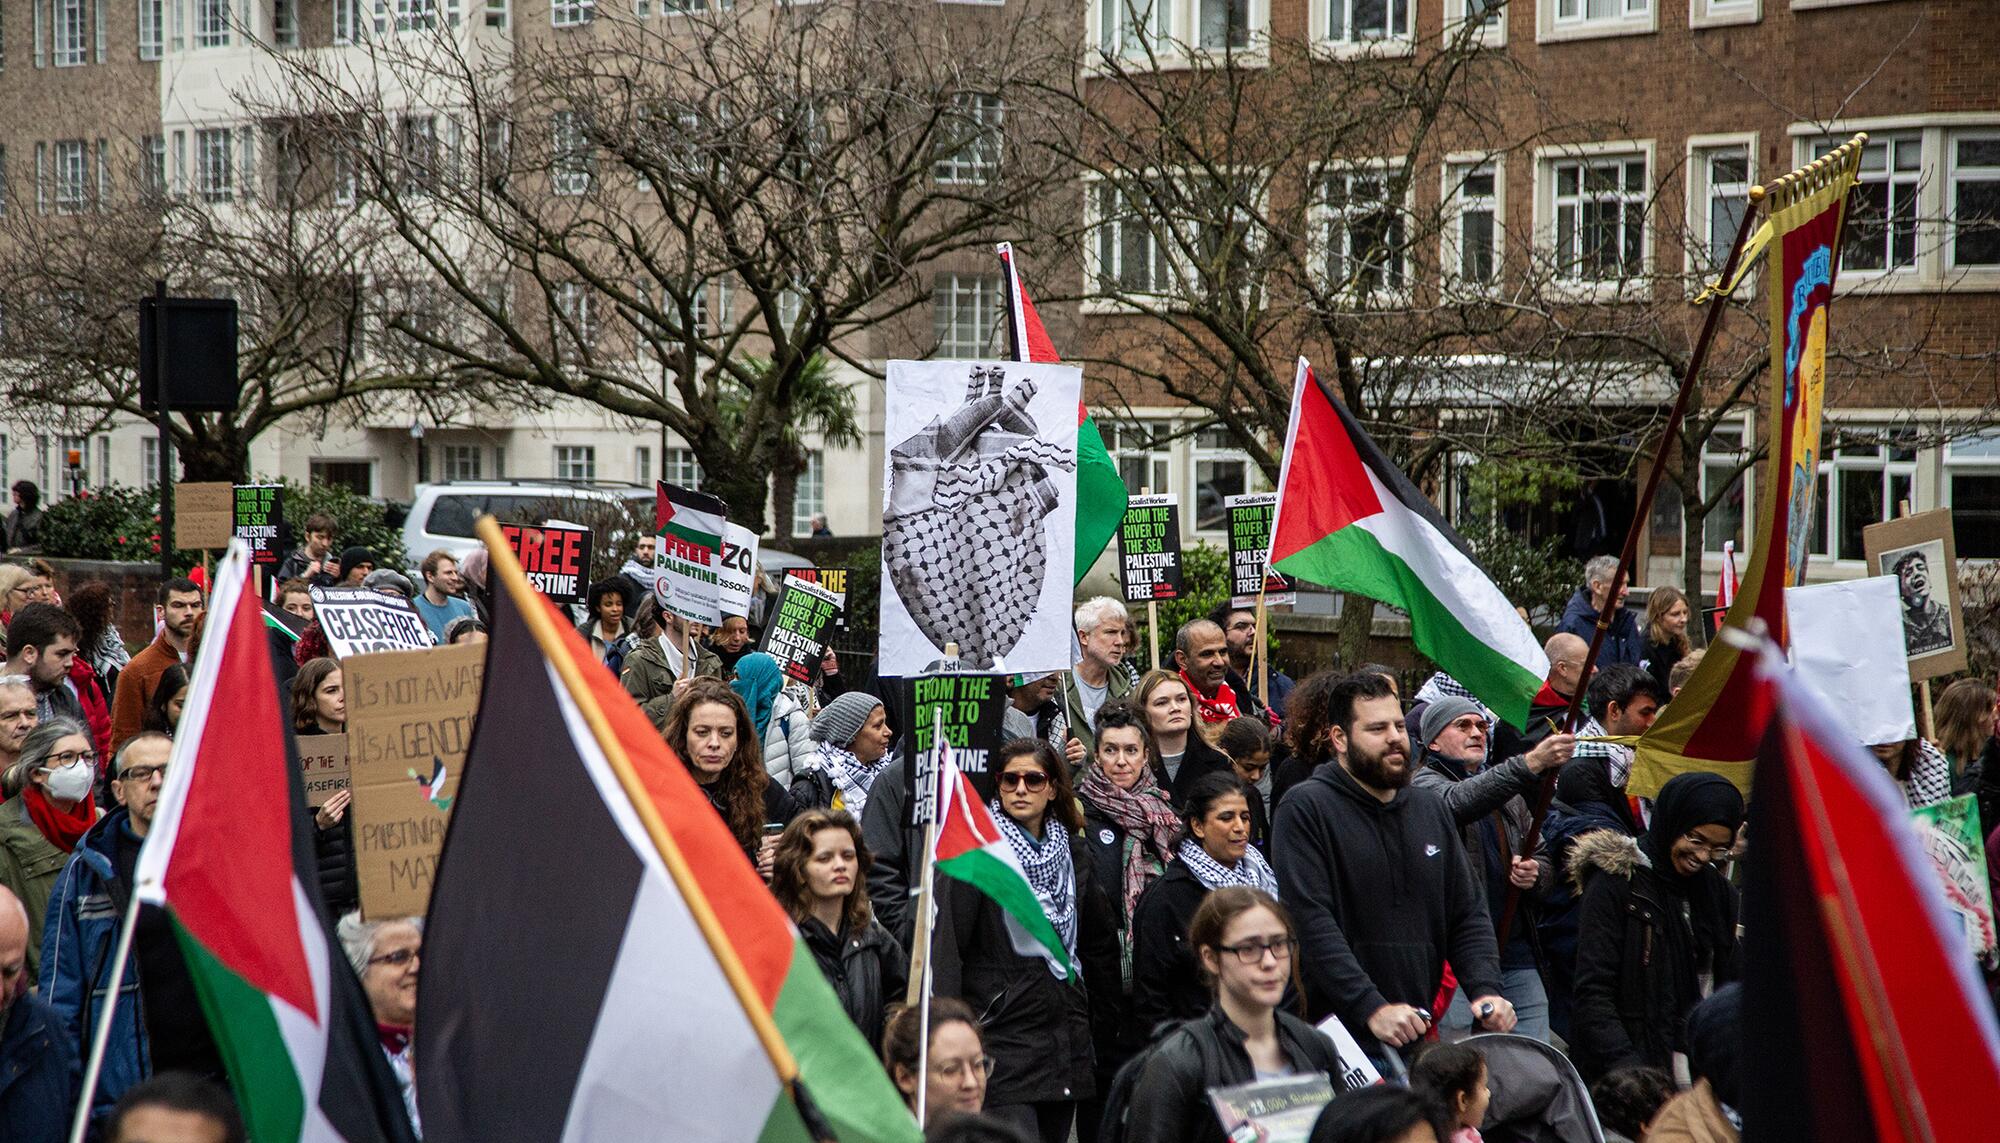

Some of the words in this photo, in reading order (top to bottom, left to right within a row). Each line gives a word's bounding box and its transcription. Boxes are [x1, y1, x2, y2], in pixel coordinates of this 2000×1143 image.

[236, 489, 257, 500] FROM
[260, 488, 275, 500] THE
[1128, 498, 1149, 506] ocialist
[1234, 497, 1260, 505] Socialist
[1260, 495, 1277, 503] Work
[236, 501, 257, 513] RIVER
[260, 501, 271, 512] TO
[1151, 507, 1170, 522] THE
[1232, 507, 1262, 522] FROM
[237, 514, 250, 525] THE
[251, 514, 267, 525] SEA
[236, 526, 277, 538] PALESTINE
[1123, 523, 1152, 539] RIVER
[1153, 522, 1166, 537] TO
[1233, 521, 1264, 536] RIVER
[255, 538, 267, 550] BE
[503, 526, 581, 575] FREE
[665, 532, 711, 567] FREE
[1124, 539, 1144, 554] THE
[1146, 537, 1163, 553] SEA
[1234, 536, 1254, 551] THE
[1256, 535, 1269, 549] SE
[720, 541, 752, 576] za
[1125, 552, 1176, 569] PALESTINE
[1235, 549, 1268, 565] PALES
[657, 553, 718, 585] PALESTINE
[1126, 568, 1152, 585] WILL
[1152, 568, 1165, 583] BE
[1235, 564, 1260, 579] WILL
[527, 572, 577, 595] ESTINE
[719, 578, 750, 595] assacre
[820, 570, 847, 593] THE
[1236, 578, 1261, 594] FREE
[794, 580, 819, 595] Socialist
[818, 589, 838, 603] Worker
[1127, 584, 1153, 600] FREE
[785, 588, 816, 610] FROM
[816, 600, 836, 618] THE
[781, 601, 811, 623] RIVER
[812, 612, 826, 628] TO
[322, 607, 428, 647] CEASEFIRE
[777, 613, 798, 632] THE
[798, 622, 817, 640] SEA
[771, 625, 823, 658] PALESTINE
[767, 638, 790, 659] WILL
[791, 649, 808, 665] BE
[384, 677, 418, 705] NOT
[424, 676, 440, 702] A
[915, 678, 956, 704] FROM
[960, 677, 993, 700] THE
[959, 701, 980, 724] TO
[385, 733, 400, 761] A
[400, 711, 477, 759] GENOCI
[299, 756, 314, 771] OP
[317, 755, 334, 769] THE
[916, 749, 989, 778] PLTINE
[304, 778, 350, 793] ASEFIRE
[390, 853, 441, 893] MAT
[1345, 1068, 1369, 1091] OR
